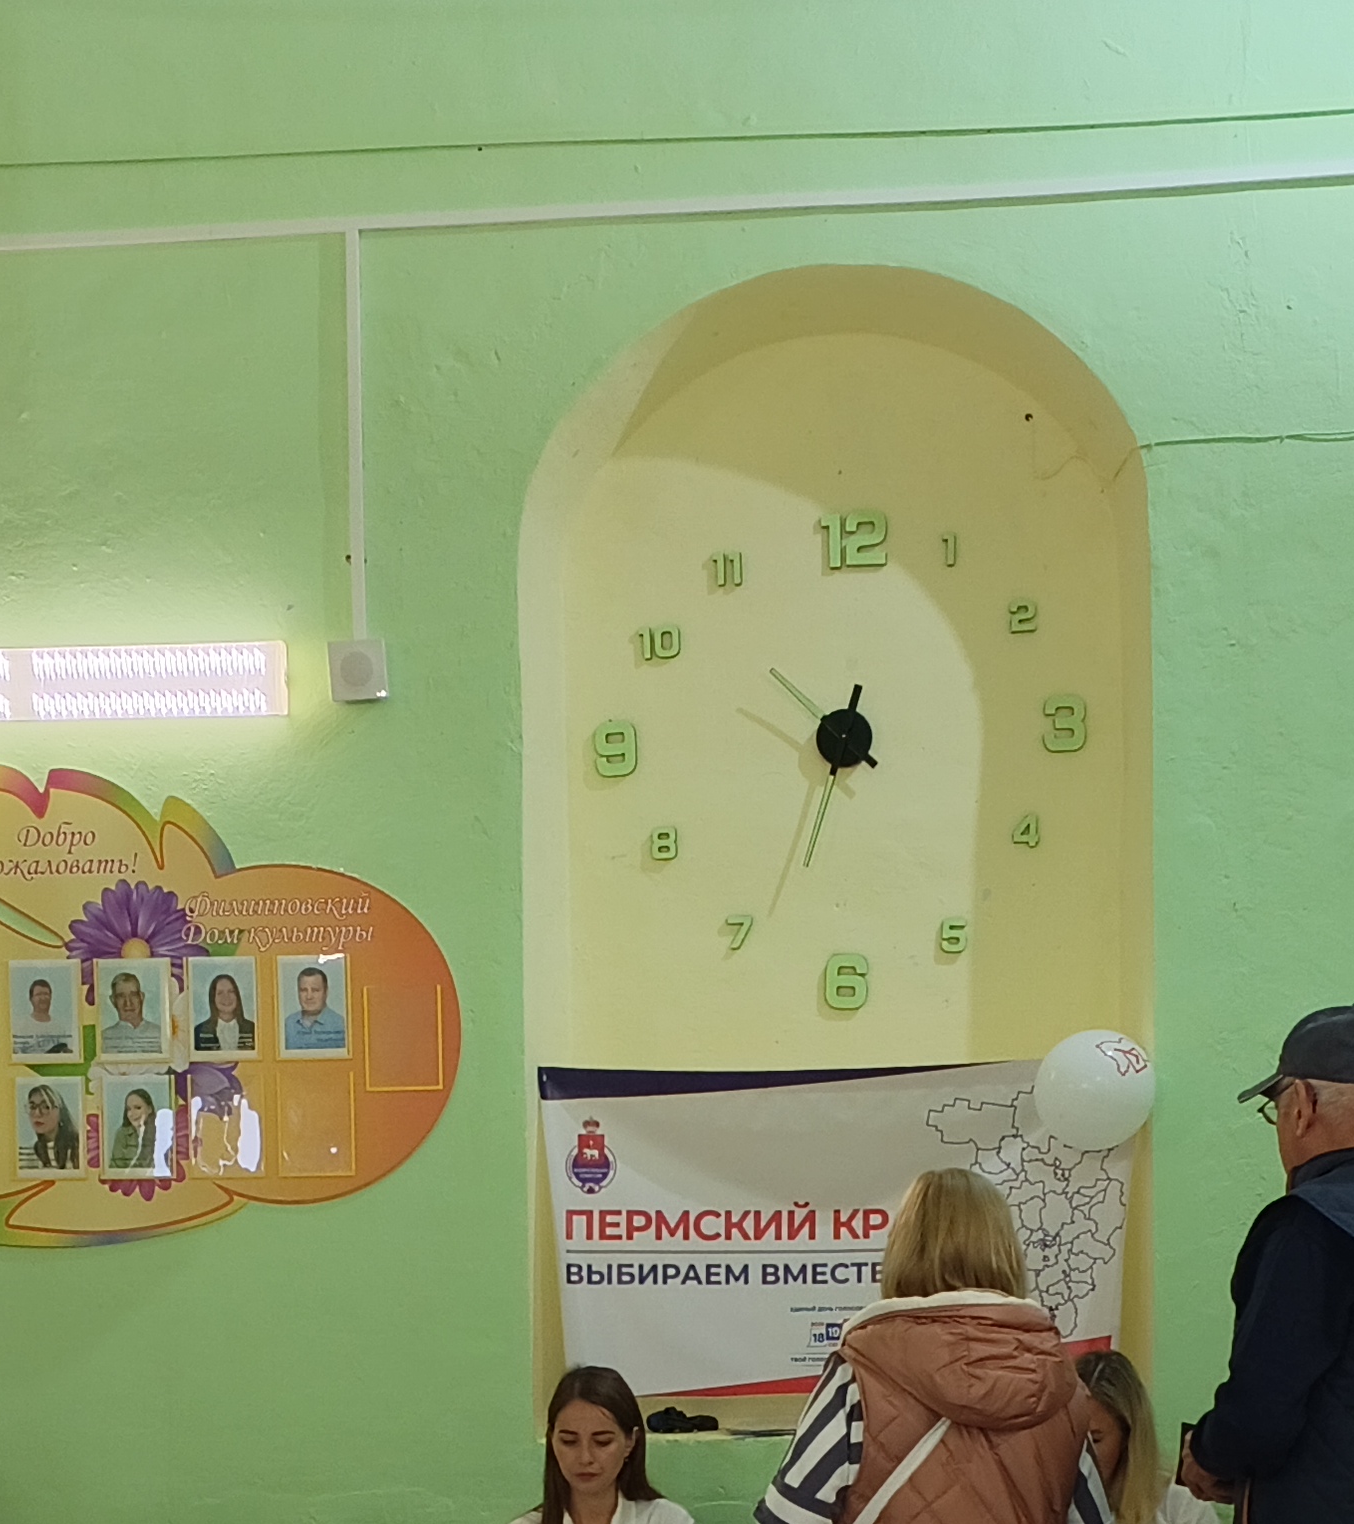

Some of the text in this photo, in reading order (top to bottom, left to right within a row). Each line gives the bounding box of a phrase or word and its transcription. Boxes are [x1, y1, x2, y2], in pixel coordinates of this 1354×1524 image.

[820, 512, 888, 569] 12
[942, 532, 957, 567] 1
[712, 551, 743, 587] 11
[1009, 599, 1037, 633] 2
[638, 625, 680, 659] 10
[1043, 695, 1086, 752] 3
[595, 721, 637, 777] 9
[17, 822, 96, 854] Добро
[651, 827, 677, 860] 8
[1013, 814, 1040, 847] 4
[185, 891, 372, 920] Филипповский
[182, 922, 374, 952] Дом культуры
[726, 916, 752, 949] 7
[941, 918, 967, 952] 5
[825, 954, 868, 1009] 6
[565, 1201, 889, 1241] ПЕРМСКИЙ КР
[566, 1261, 883, 1285] ВЫБИРАЕМ ВМЕСТЕ
